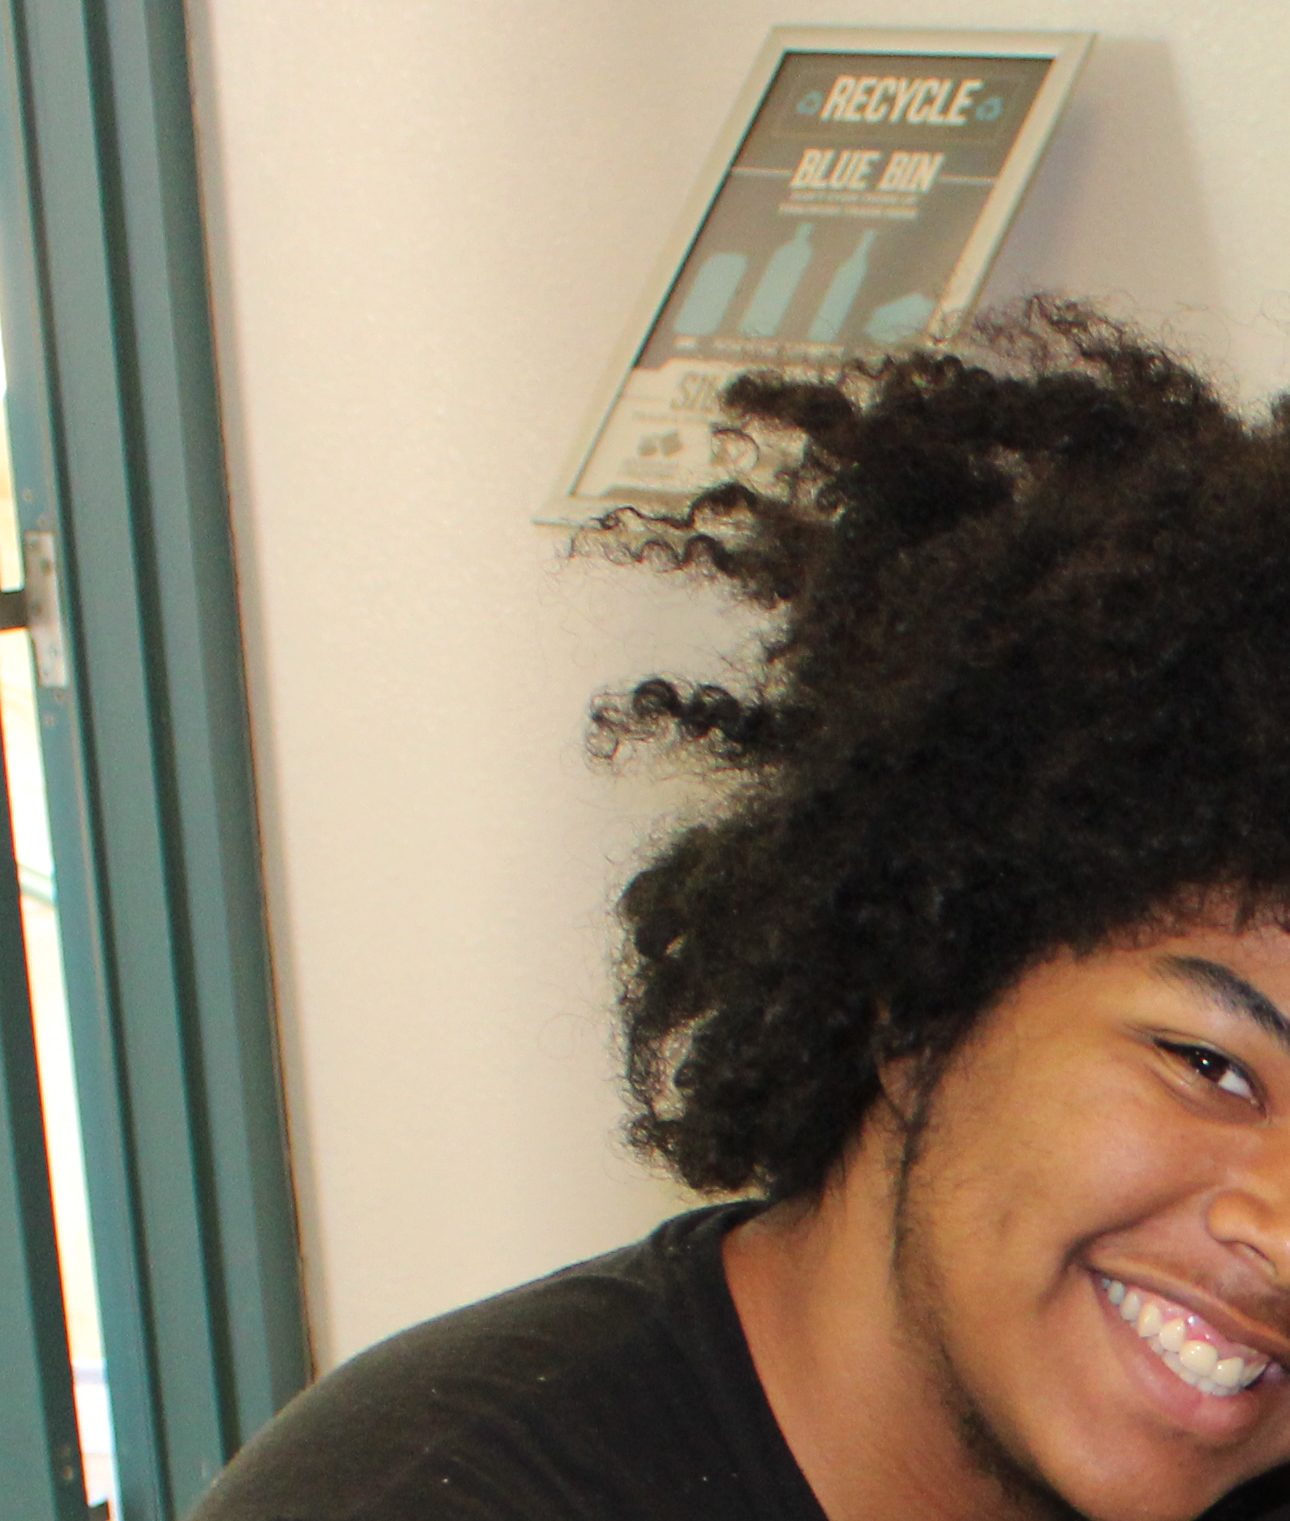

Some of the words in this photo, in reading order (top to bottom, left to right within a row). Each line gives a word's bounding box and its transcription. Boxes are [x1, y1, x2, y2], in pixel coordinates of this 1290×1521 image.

[821, 75, 982, 126] RECYCLE
[790, 148, 880, 191] BLUE
[880, 151, 945, 192] BIN
